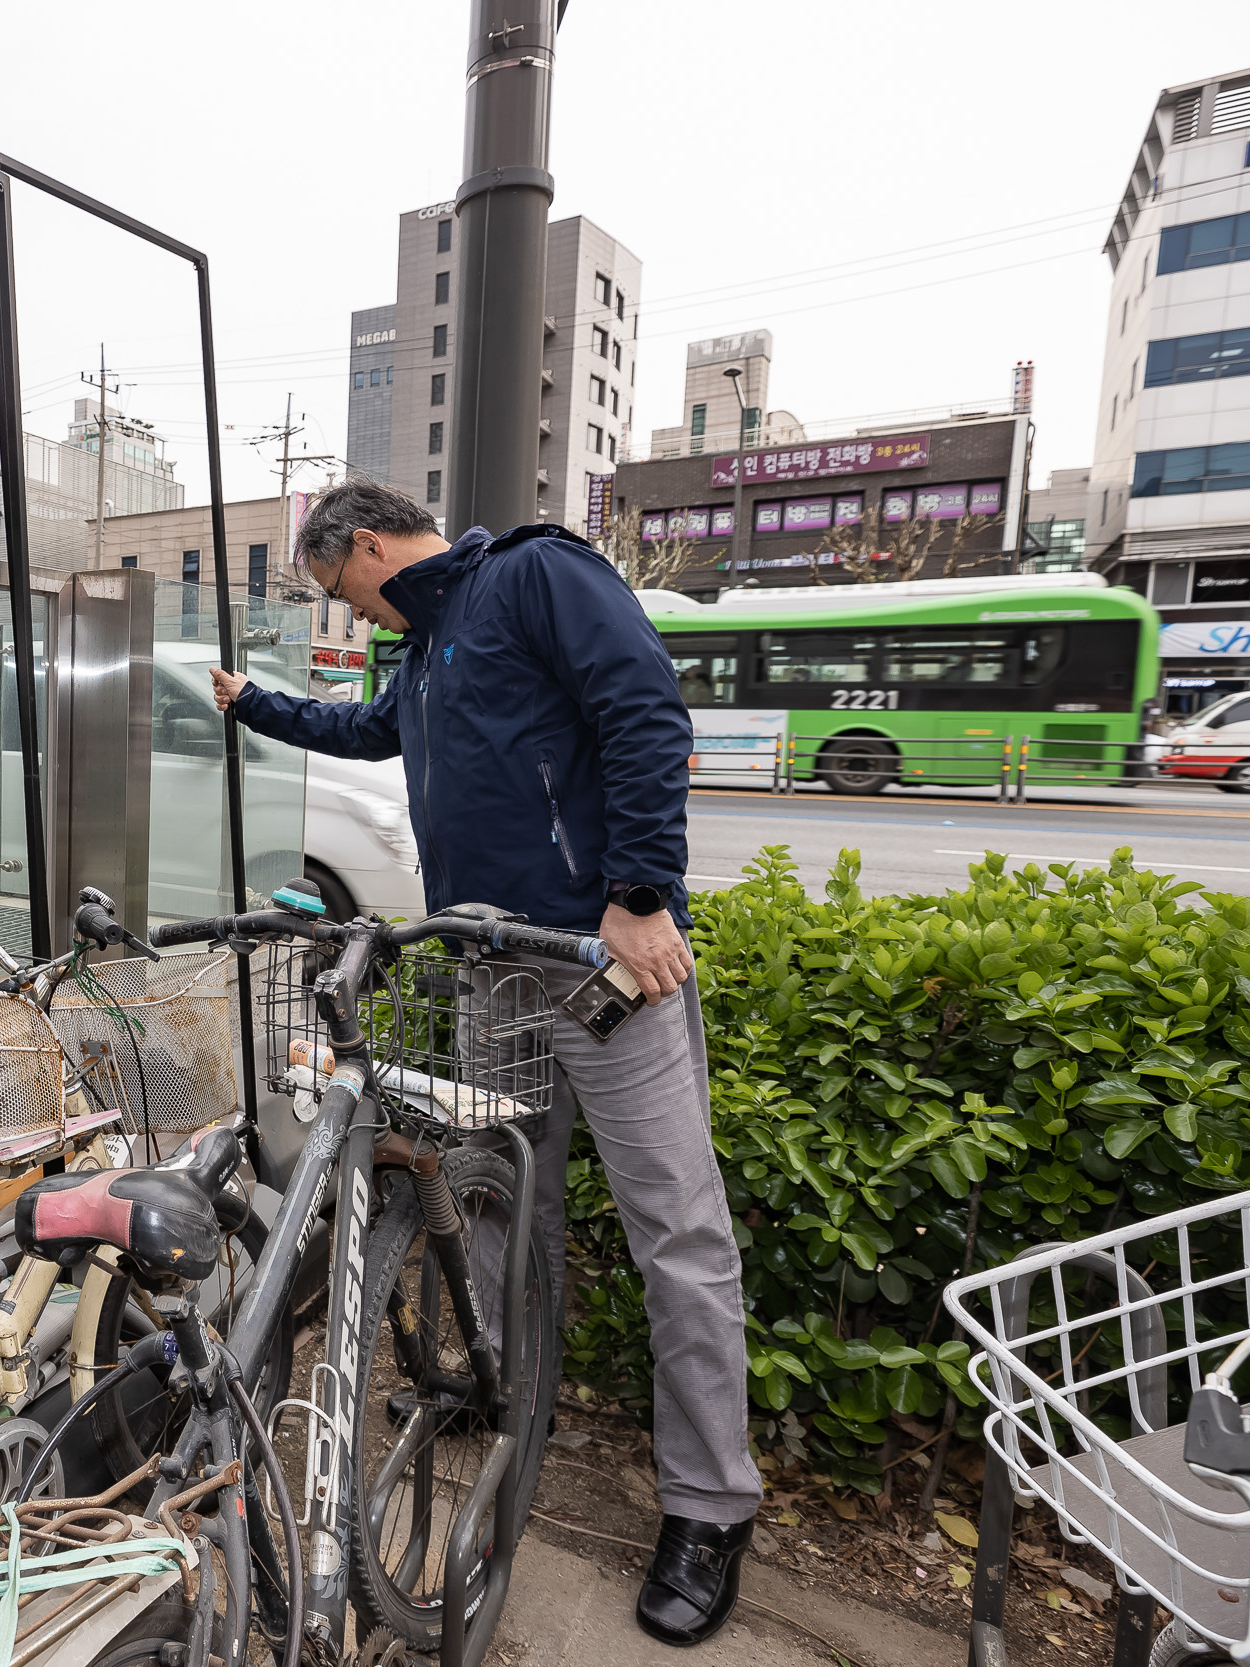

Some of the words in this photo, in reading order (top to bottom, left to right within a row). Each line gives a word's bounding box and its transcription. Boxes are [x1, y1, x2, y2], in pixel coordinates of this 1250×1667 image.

[763, 448, 822, 474] 컴퓨터방
[825, 443, 874, 467] 전화방
[830, 690, 899, 710] 2221
[340, 1165, 370, 1456] LESPO
